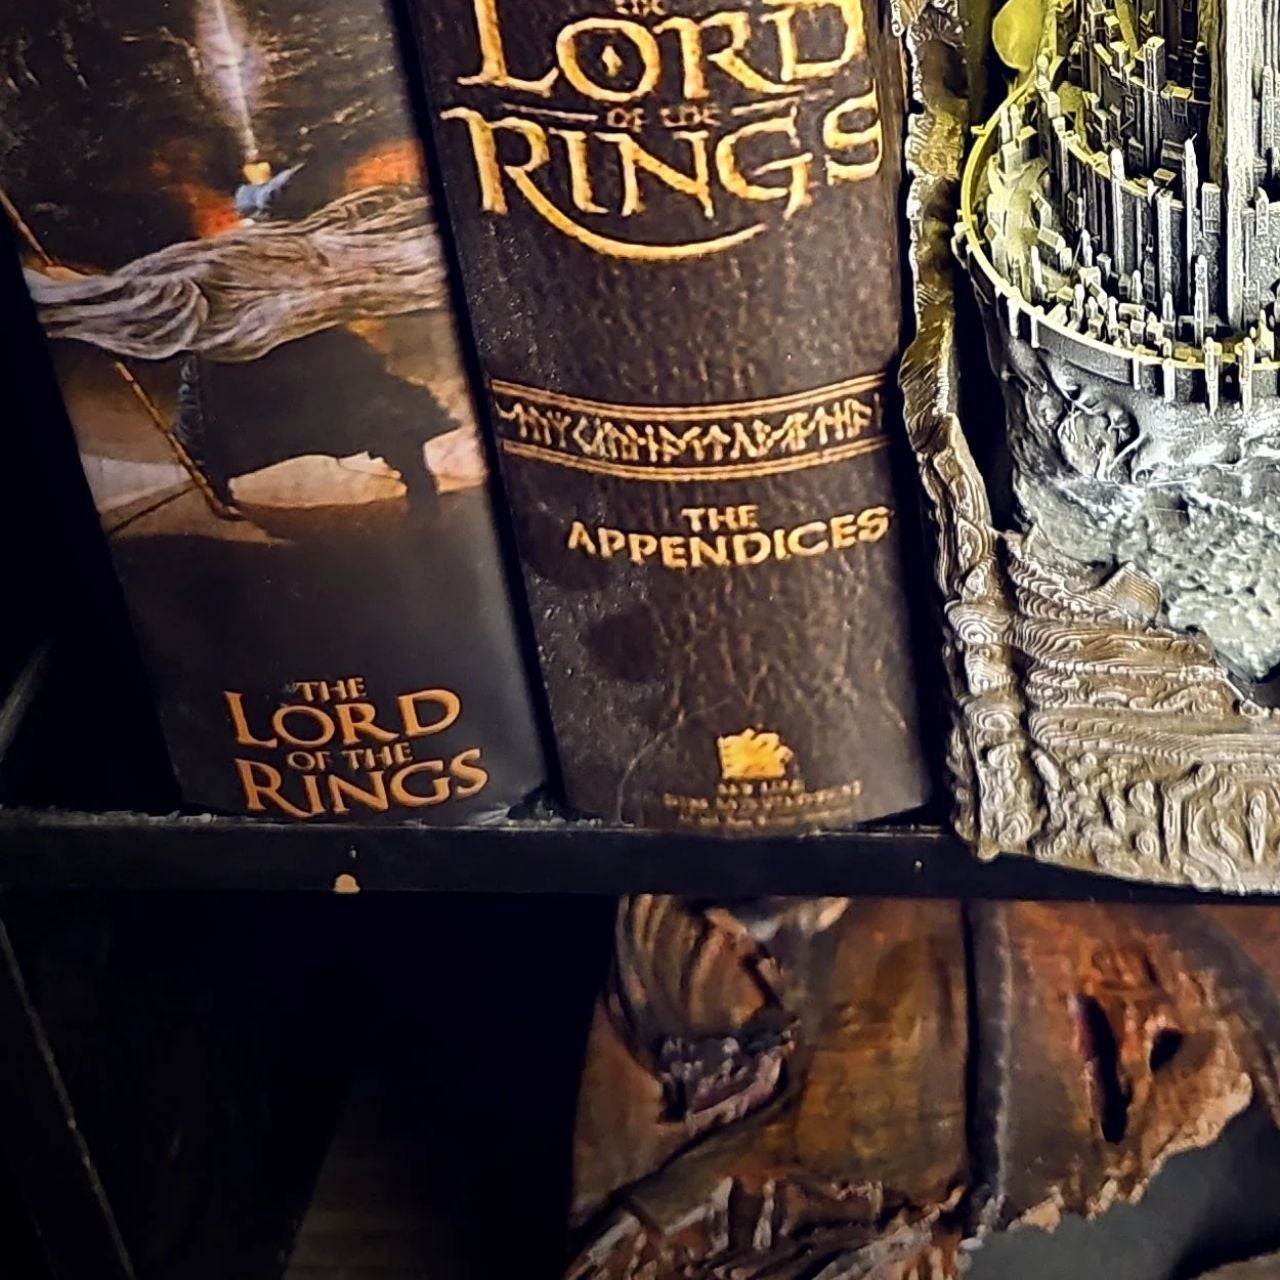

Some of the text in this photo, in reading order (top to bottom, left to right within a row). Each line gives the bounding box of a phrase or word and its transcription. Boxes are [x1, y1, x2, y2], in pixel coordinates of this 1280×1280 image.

[440, 79, 884, 261] RINGS
[567, 506, 890, 570] APPENDICES
[681, 504, 760, 532] THE
[223, 688, 462, 749] LORD
[297, 677, 367, 702] THE
[234, 748, 489, 818] RINGS
[286, 741, 414, 771] OF THE
